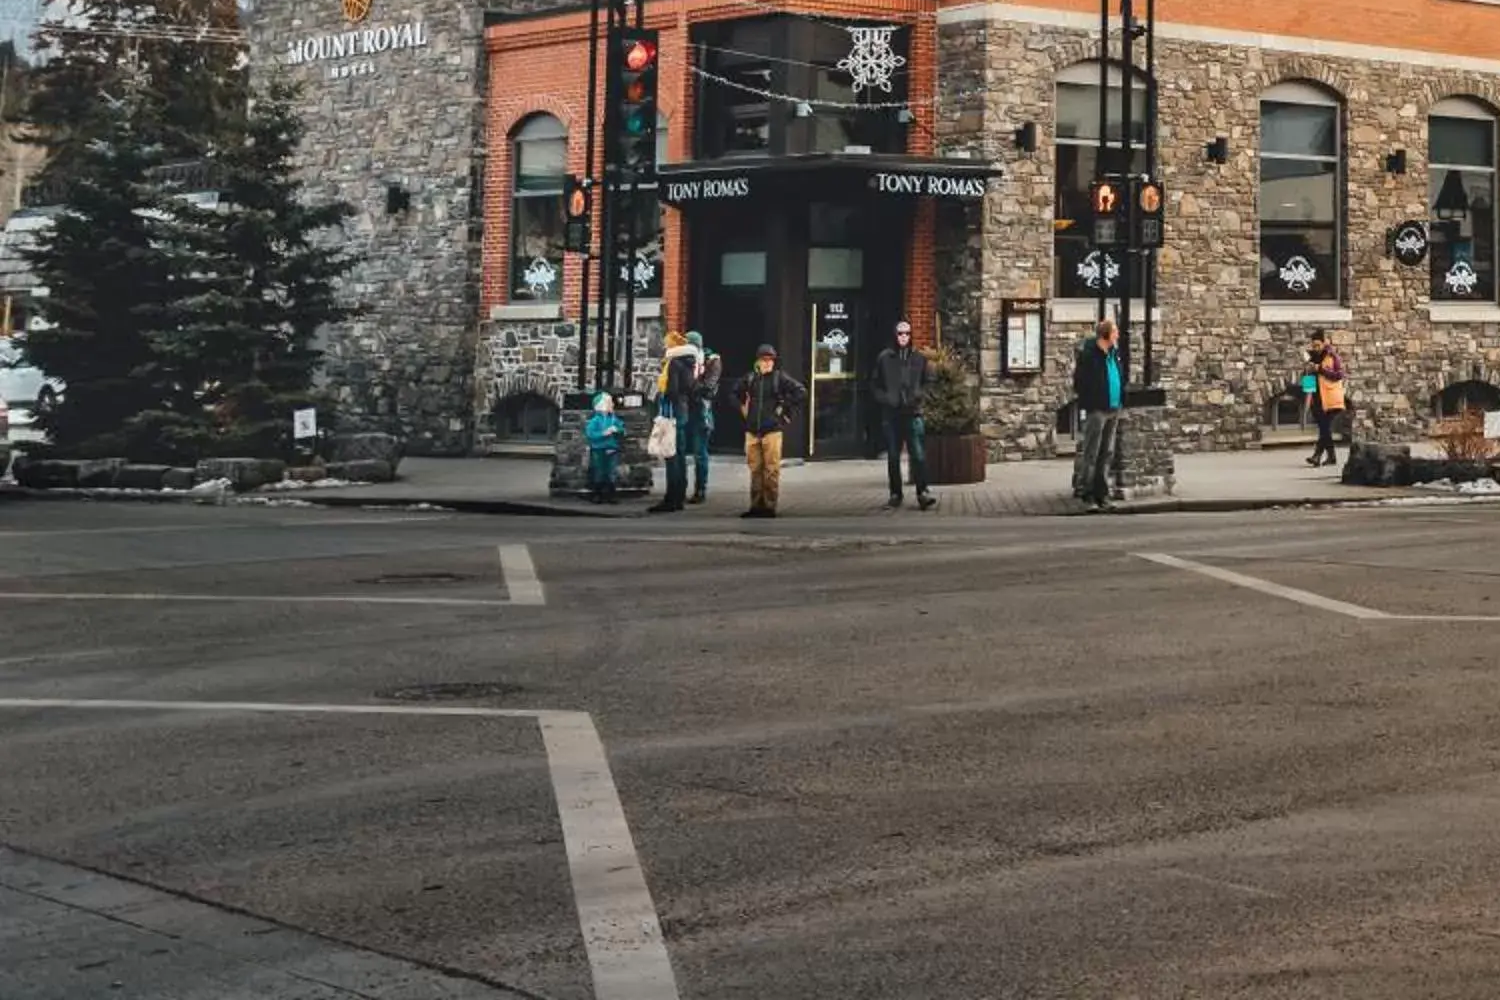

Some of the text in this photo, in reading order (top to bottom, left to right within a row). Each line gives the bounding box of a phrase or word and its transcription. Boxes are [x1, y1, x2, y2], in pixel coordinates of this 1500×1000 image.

[287, 22, 427, 65] MOUNT ROYAL
[330, 61, 375, 78] HOTEL
[667, 181, 700, 200] TONY
[876, 173, 924, 193] TONY
